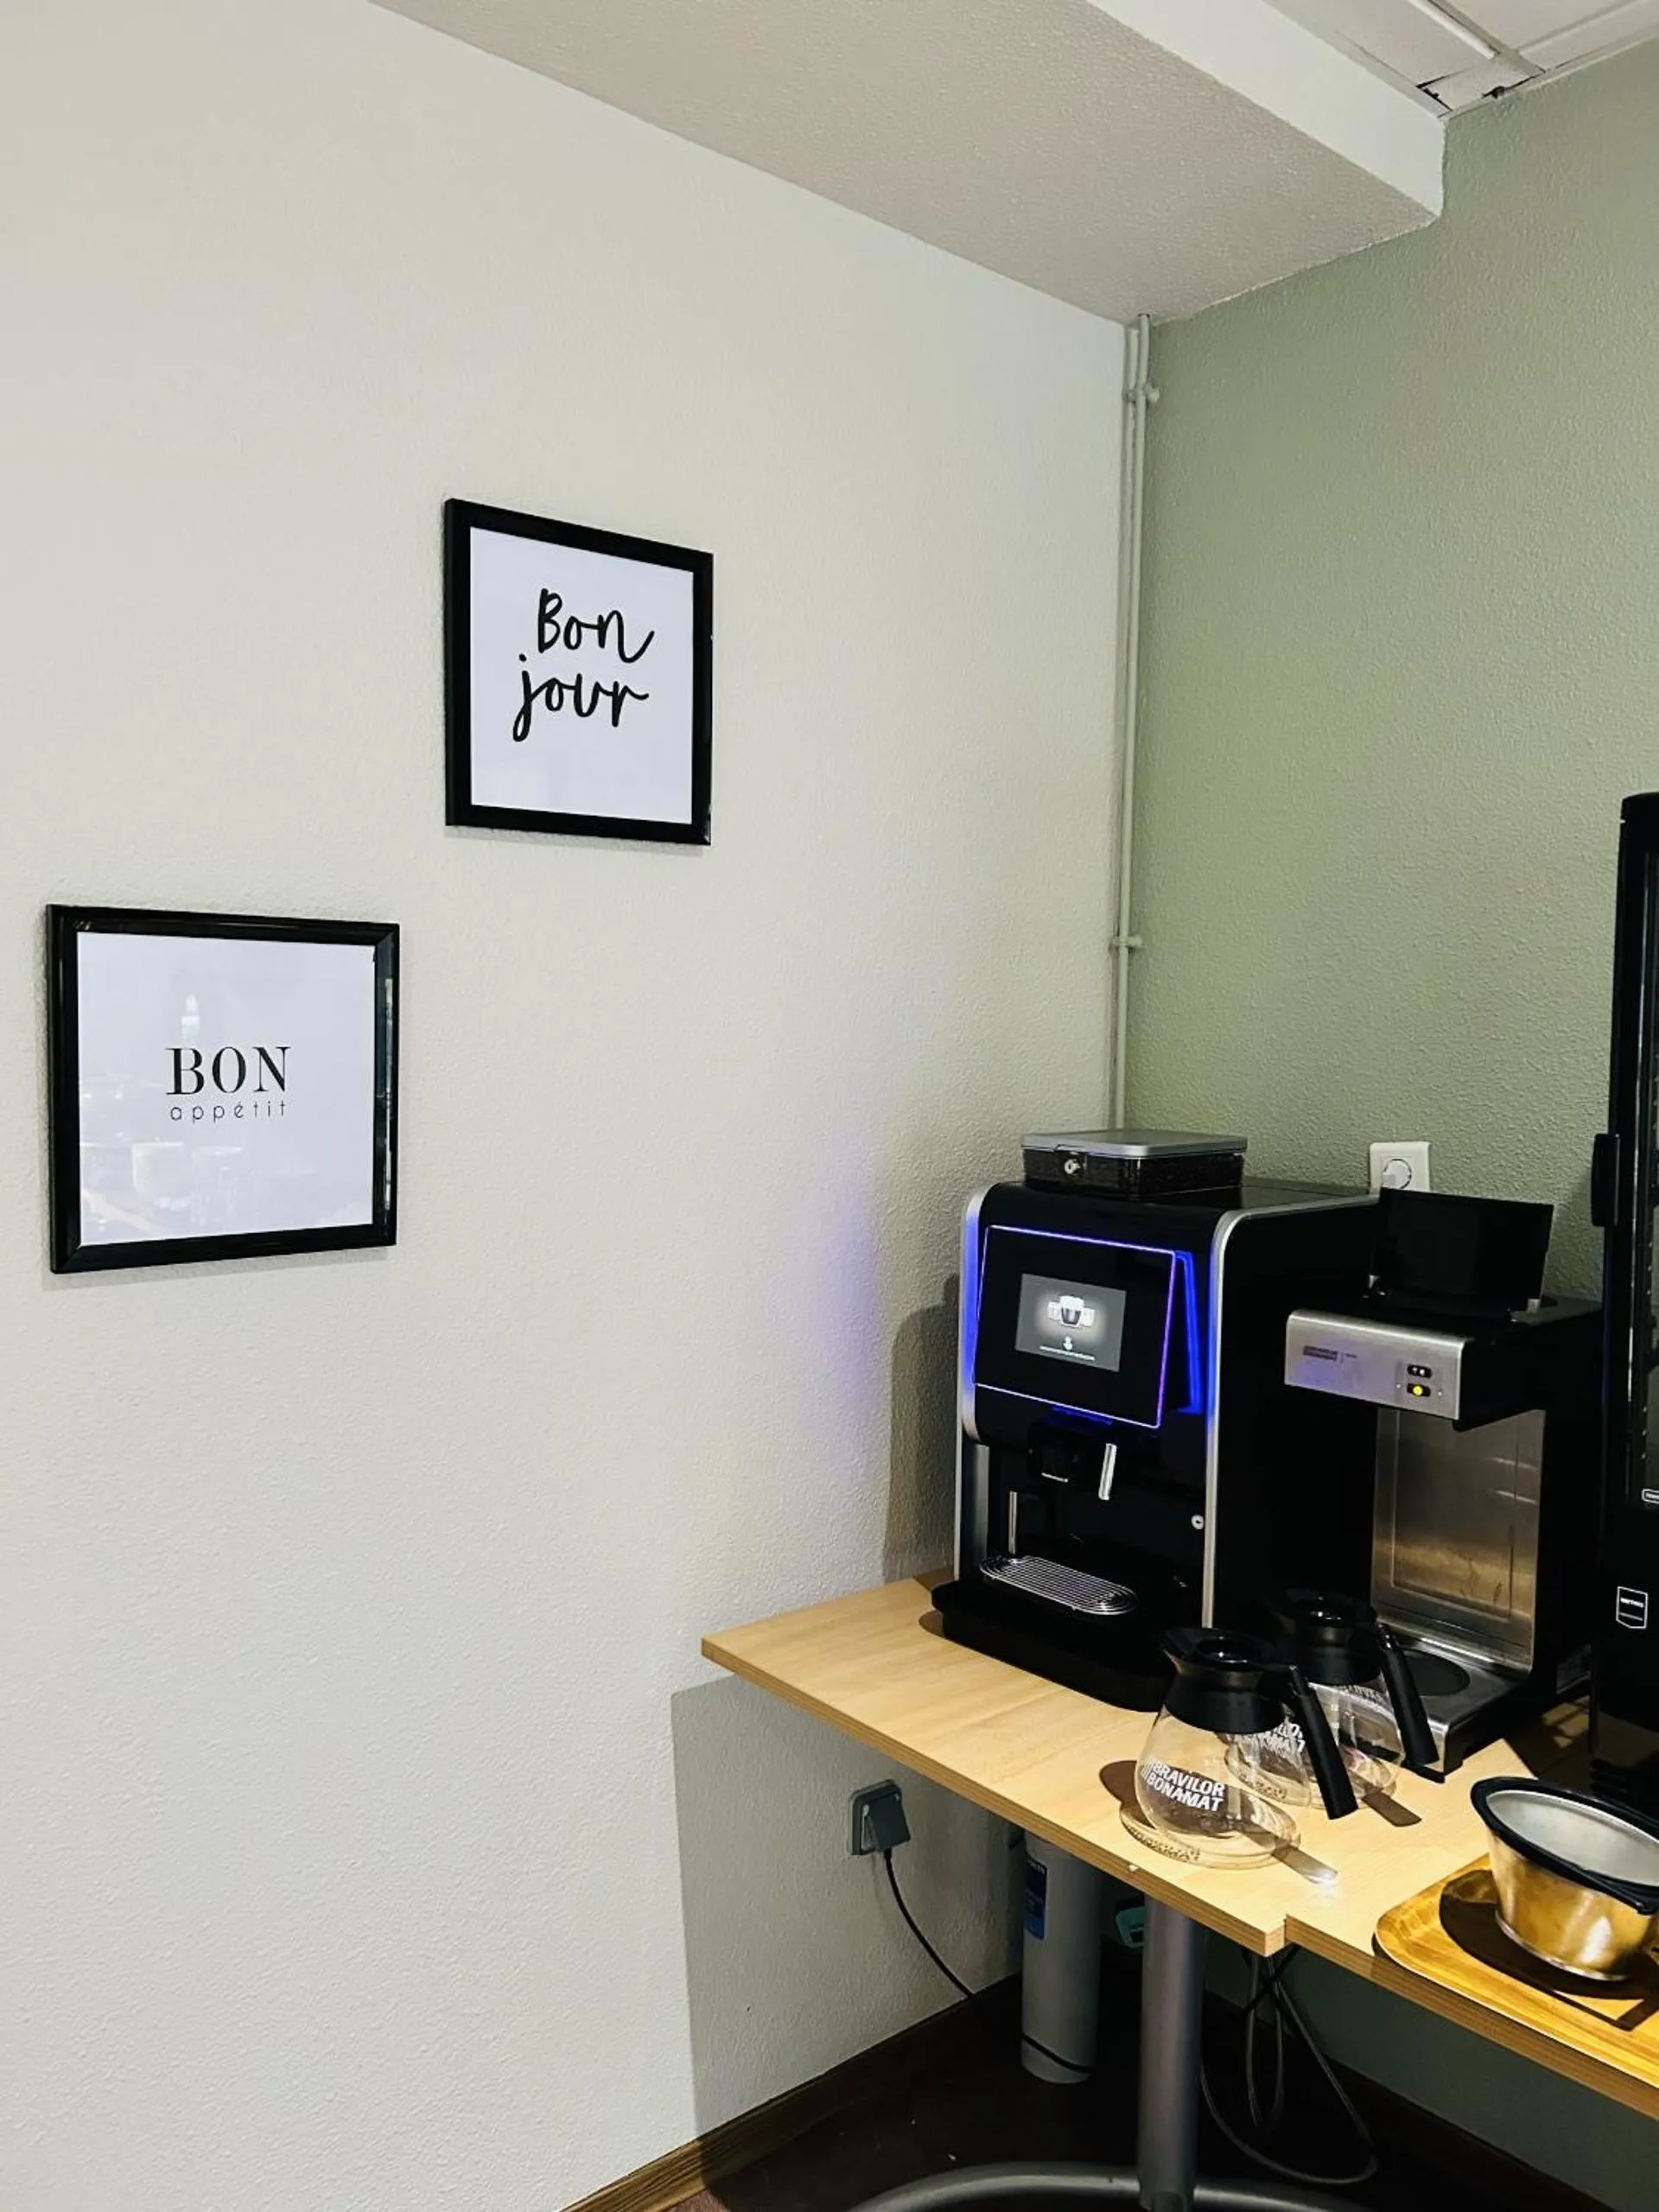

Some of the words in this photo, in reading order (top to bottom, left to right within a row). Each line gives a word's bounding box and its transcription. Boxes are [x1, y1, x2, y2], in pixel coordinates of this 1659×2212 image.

[537, 588, 655, 664] Bon
[512, 653, 650, 742] jour
[165, 1046, 291, 1096] BON
[170, 1100, 287, 1123] appétit
[1147, 1772, 1224, 1811] BONAMAT
[1152, 1761, 1225, 1796] BRAVILOR
